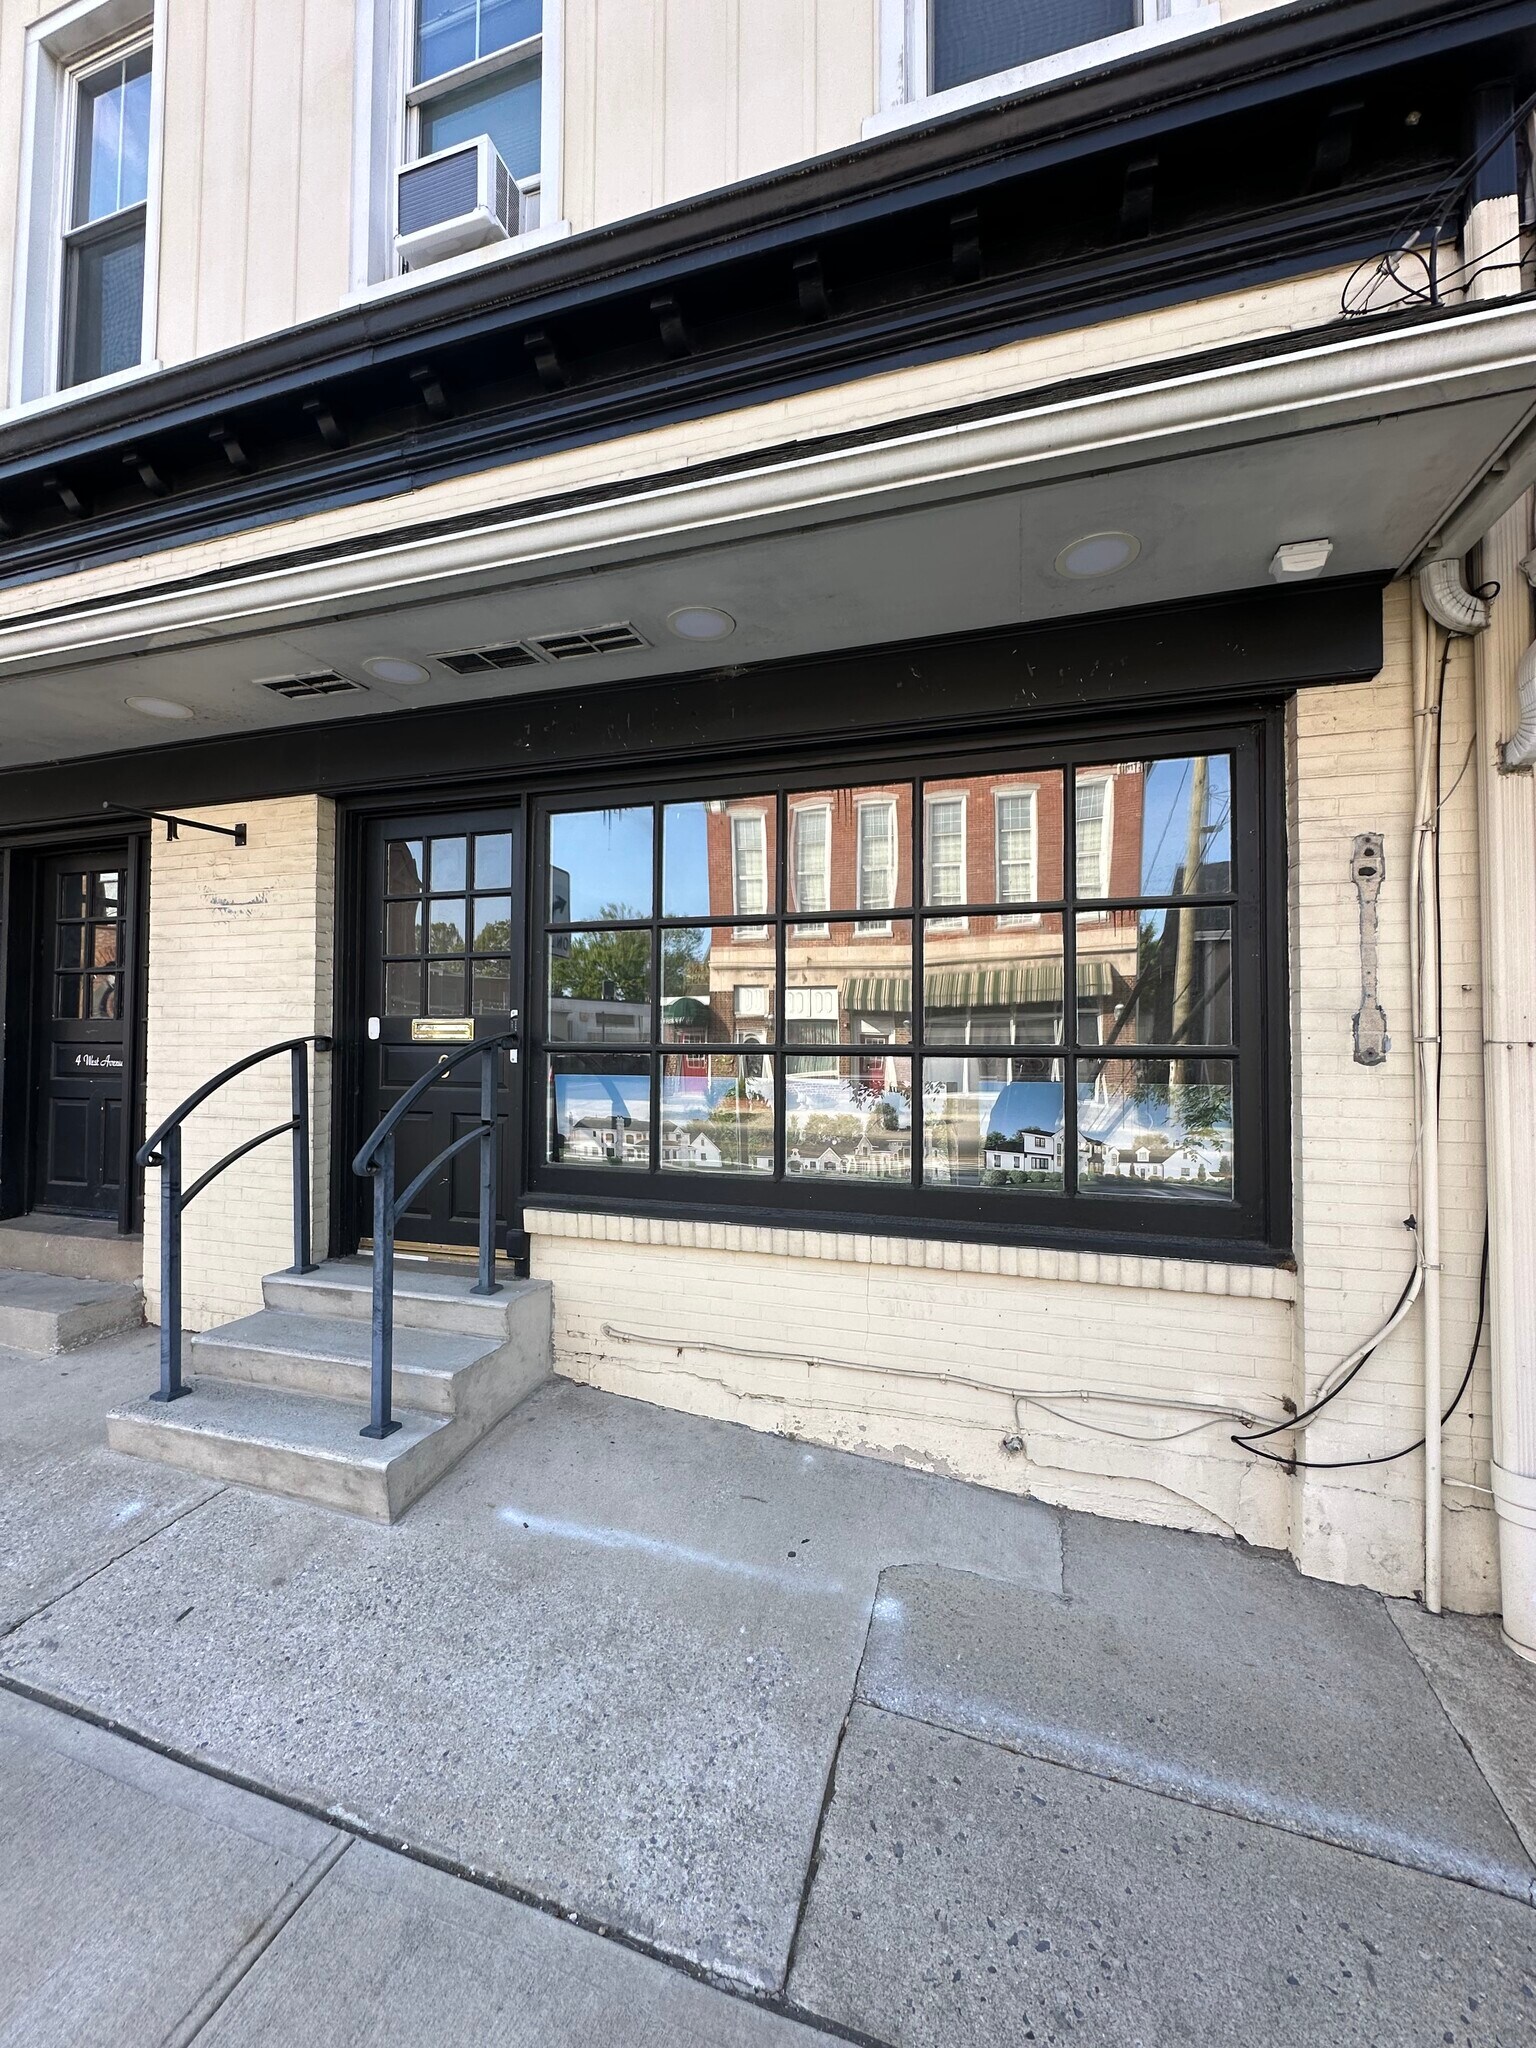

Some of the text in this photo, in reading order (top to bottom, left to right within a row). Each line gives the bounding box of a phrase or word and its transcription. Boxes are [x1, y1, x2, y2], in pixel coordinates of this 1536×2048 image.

[75, 1054, 123, 1067] 4 West Avenu
